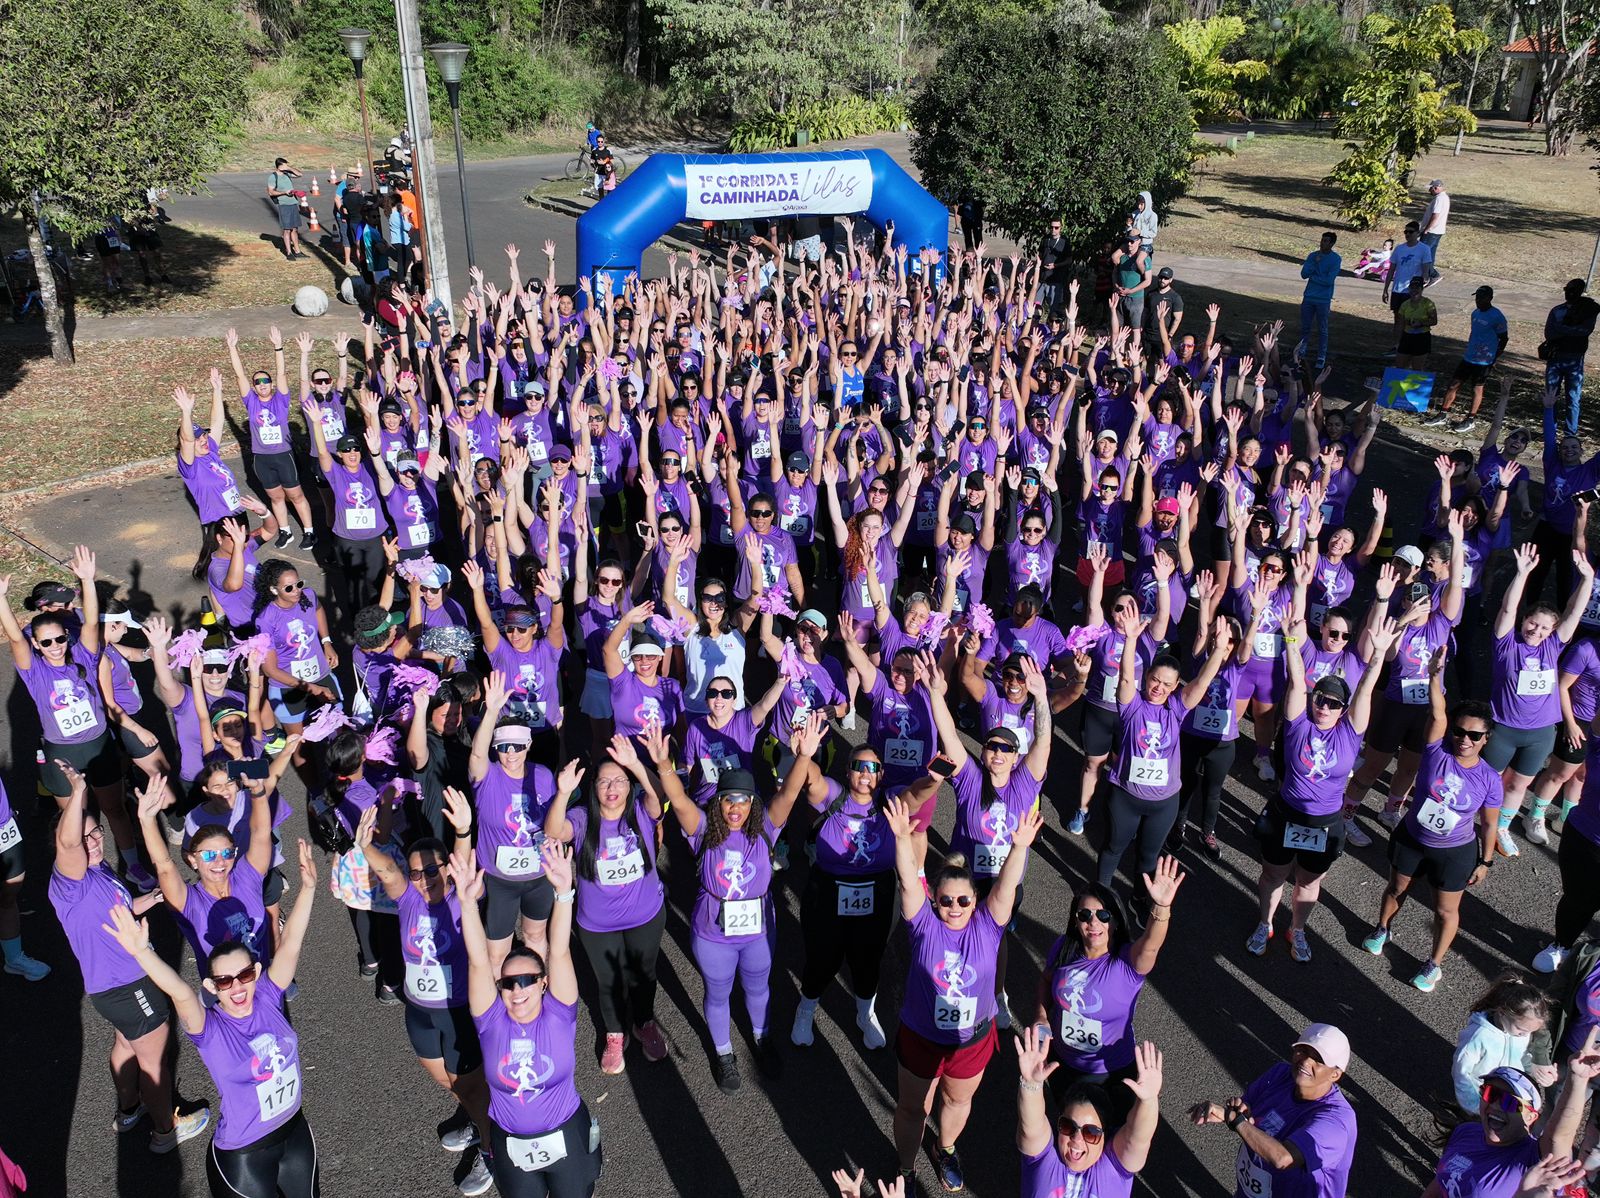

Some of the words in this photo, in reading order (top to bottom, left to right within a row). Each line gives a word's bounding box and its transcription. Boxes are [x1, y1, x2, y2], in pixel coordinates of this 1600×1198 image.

[716, 174, 787, 188] CORRIDA
[790, 173, 799, 186] E
[800, 166, 862, 203] Lilás
[699, 189, 800, 204] CAMINHADA
[262, 432, 280, 441] 222
[530, 449, 543, 457] 14
[354, 516, 368, 524] 70
[786, 521, 805, 533] 182
[416, 529, 434, 540] 175
[1259, 641, 1274, 652] 31
[296, 664, 318, 680] 132
[1529, 680, 1546, 690] 93
[61, 710, 93, 730] 302
[1202, 716, 1220, 729] 25
[890, 748, 917, 761] 292
[1136, 767, 1163, 780] 272
[1427, 813, 1446, 829] 19
[1290, 831, 1319, 845] 271
[508, 857, 529, 869] 26
[606, 864, 639, 880] 294
[841, 897, 871, 910] 148
[728, 912, 757, 928] 221
[417, 978, 438, 993] 62
[937, 1008, 971, 1023] 281
[1064, 1026, 1099, 1046] 236
[265, 1079, 295, 1110] 177
[524, 1150, 550, 1165] 13
